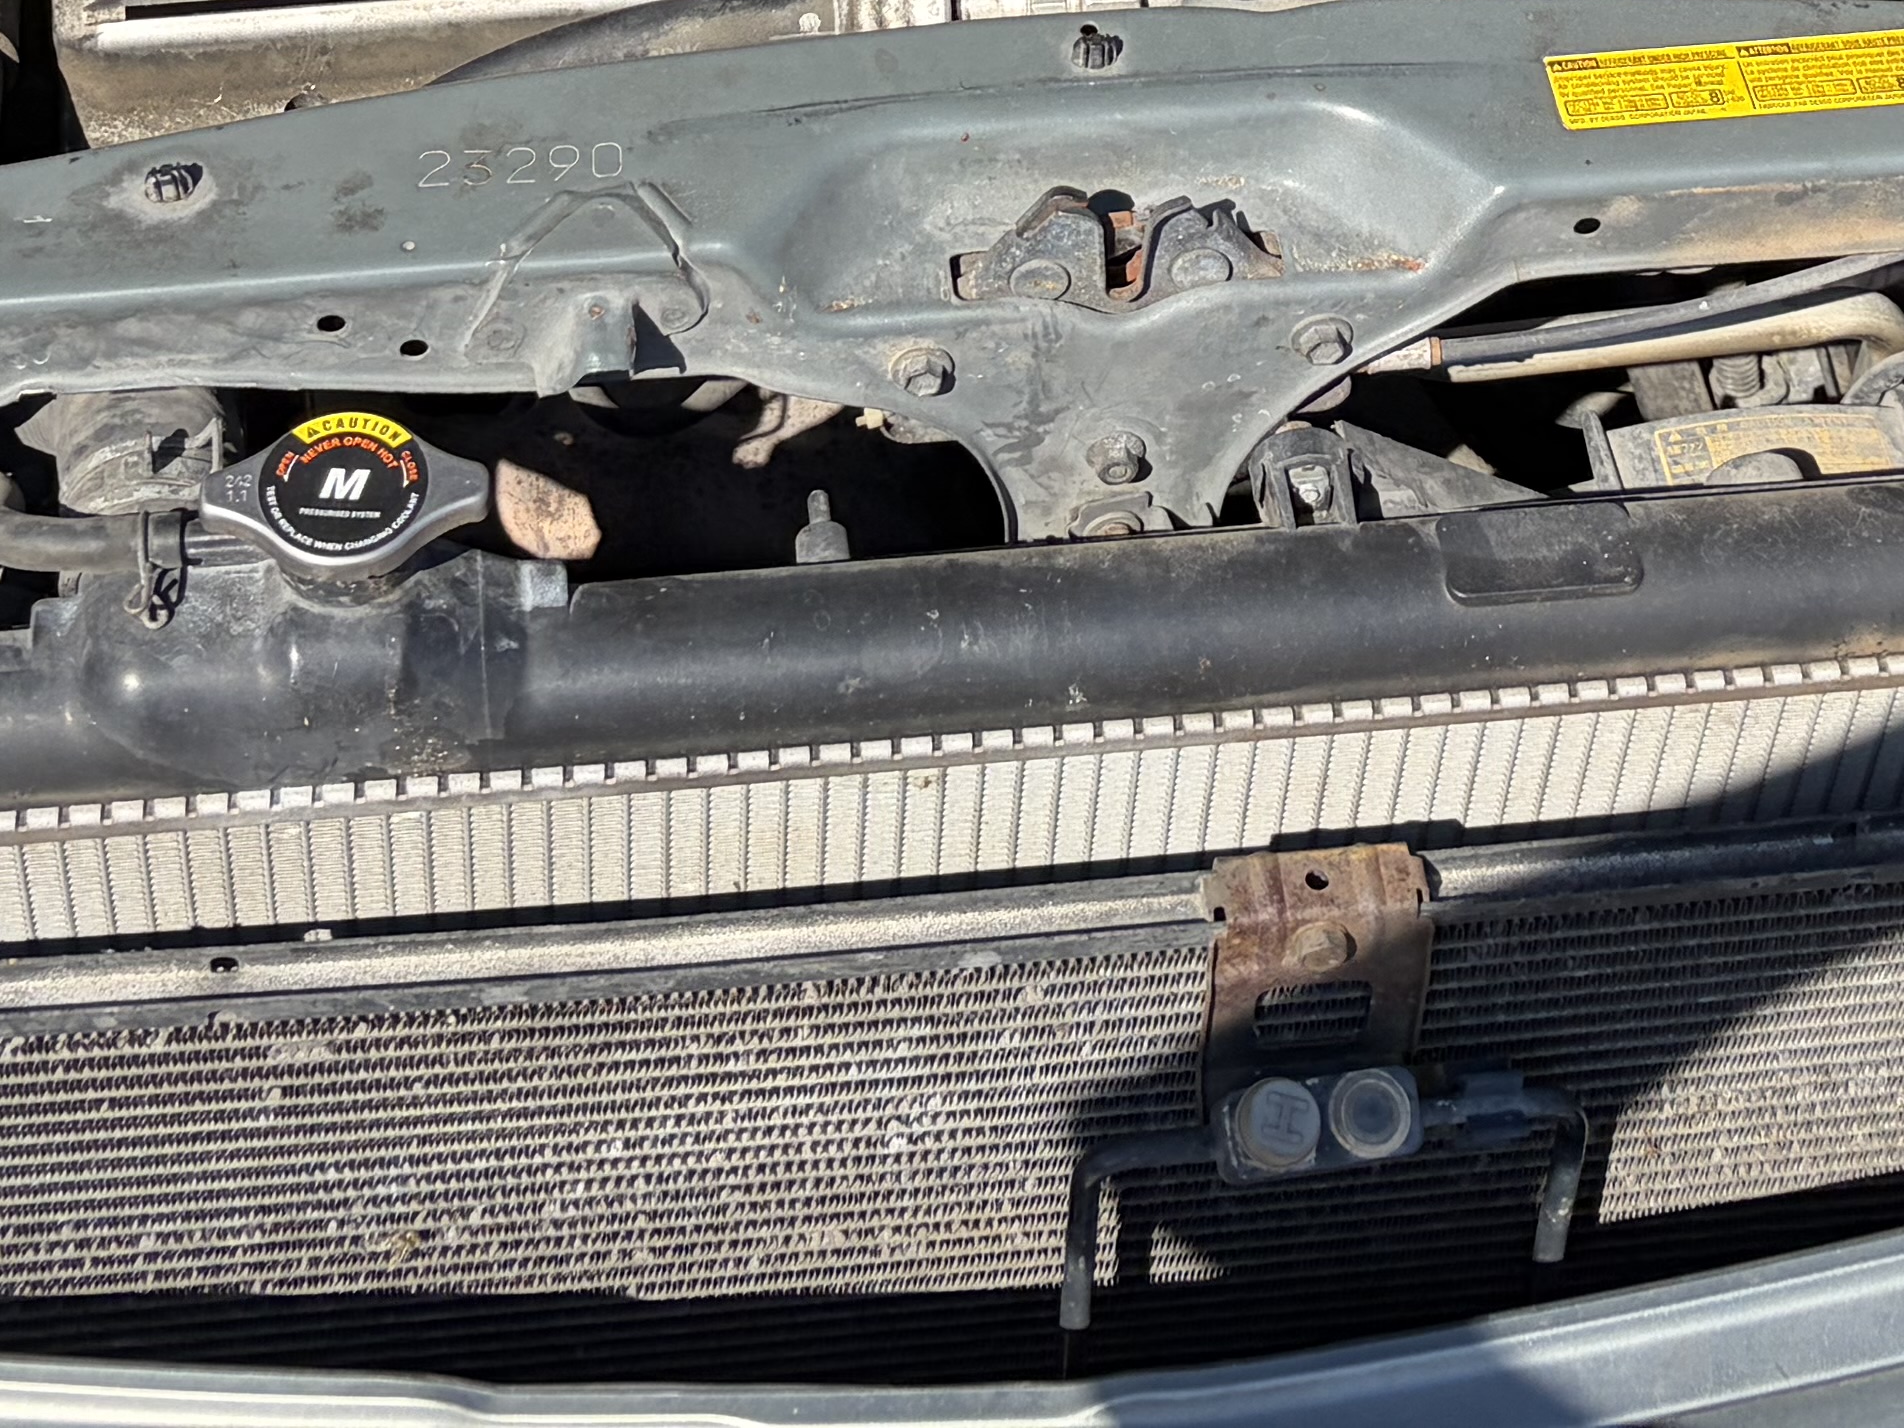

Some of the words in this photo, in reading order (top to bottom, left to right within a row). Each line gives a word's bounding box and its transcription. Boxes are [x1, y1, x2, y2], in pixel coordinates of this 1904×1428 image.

[1709, 91, 1720, 103] 8
[418, 142, 623, 188] 23290
[323, 417, 403, 443] CAUTION
[275, 450, 295, 477] OPEN
[299, 436, 341, 465] NEVER
[342, 435, 377, 452] OPEN
[376, 446, 399, 469] HOT
[400, 449, 419, 482] CLOSE
[224, 474, 253, 488] 242
[318, 467, 371, 501] M
[265, 485, 279, 506] TEST
[270, 506, 283, 520] OR
[351, 510, 382, 519] SYSTEM
[391, 492, 420, 530] COOLANT
[278, 518, 314, 547] REPLACE
[313, 540, 343, 551] WHEN
[343, 527, 394, 551] CHANGING
